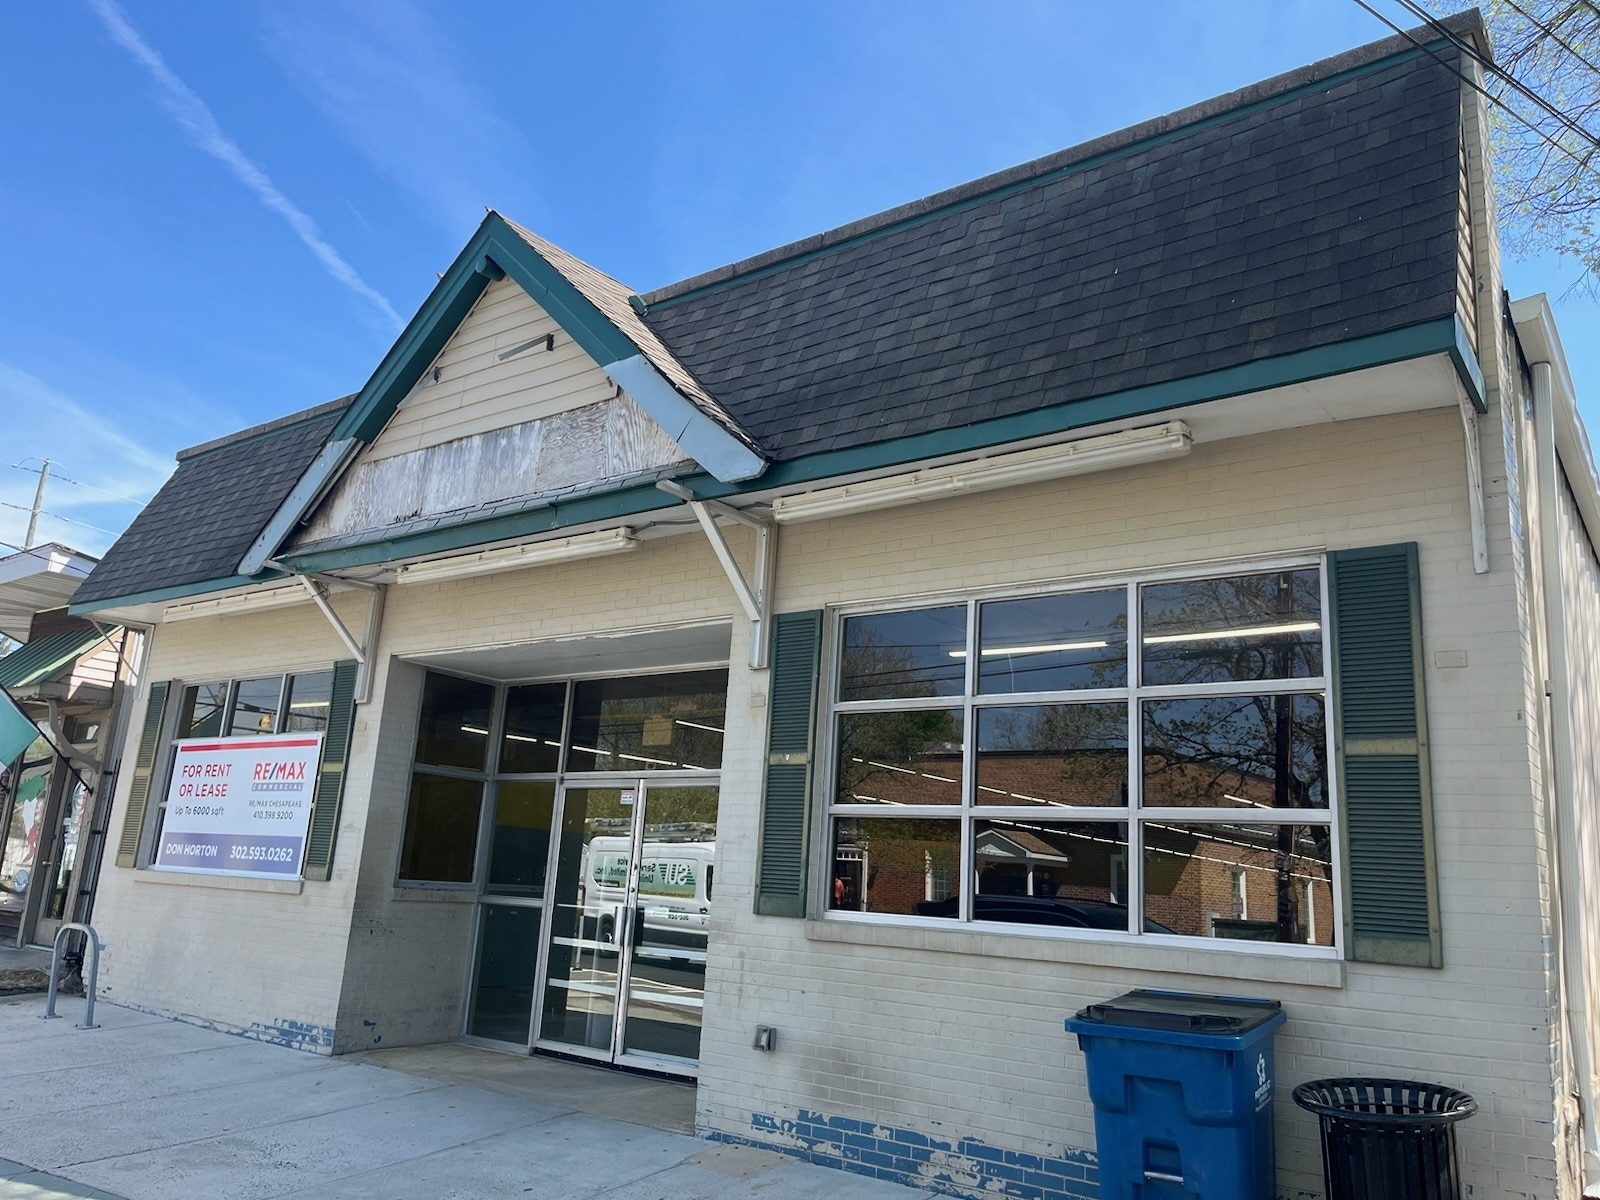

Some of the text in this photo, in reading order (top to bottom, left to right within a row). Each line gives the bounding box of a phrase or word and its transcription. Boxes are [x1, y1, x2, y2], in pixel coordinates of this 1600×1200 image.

[181, 763, 232, 778] FOR RENT
[253, 761, 307, 781] RE/MAX
[179, 783, 228, 797] OR LEASE
[252, 783, 303, 791] COMMERCIAL
[175, 806, 224, 816] Up To 6000 sqft
[249, 800, 302, 808] RE/MAX CHESAPEAKE
[253, 811, 293, 820] 410.398.9200
[166, 843, 218, 857] DON HORTON
[230, 845, 293, 862] 302.593.0262
